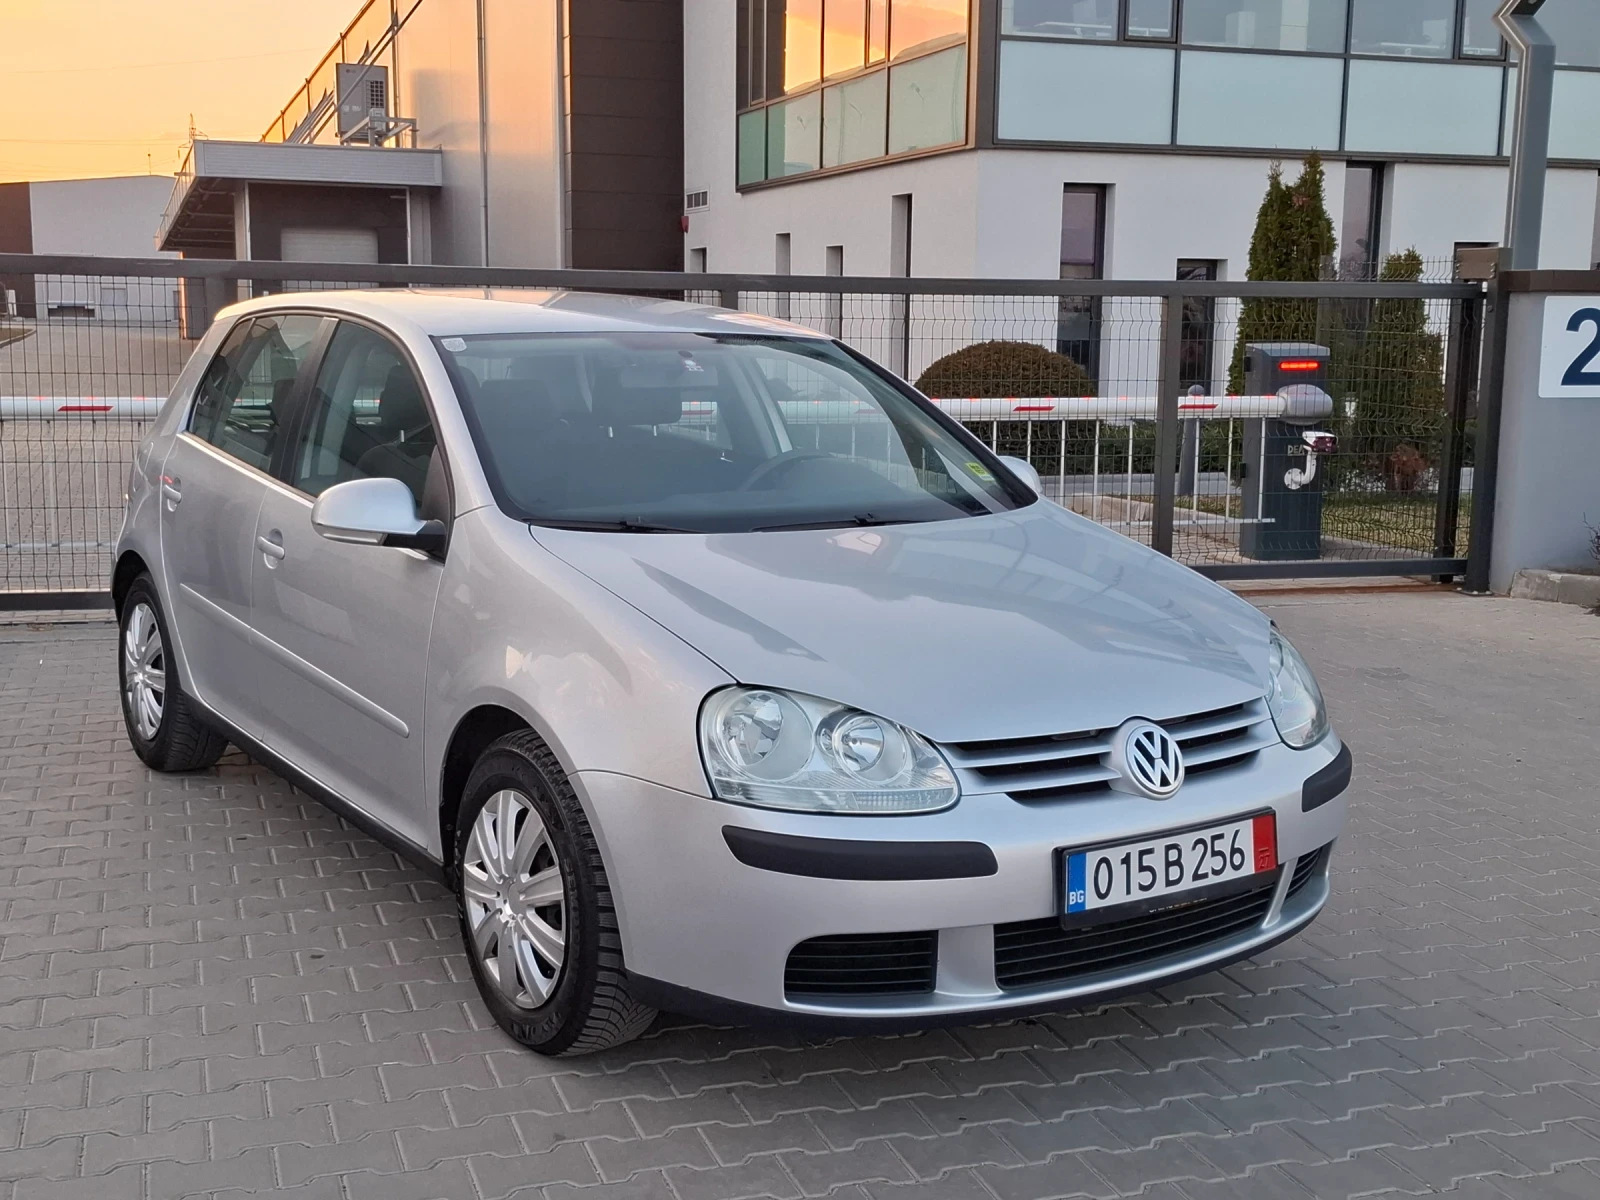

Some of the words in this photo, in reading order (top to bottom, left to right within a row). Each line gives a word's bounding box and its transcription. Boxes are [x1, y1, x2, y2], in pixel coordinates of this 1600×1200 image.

[1561, 307, 1600, 386] 2
[1069, 889, 1085, 905] BG
[1093, 829, 1246, 900] 015B256
